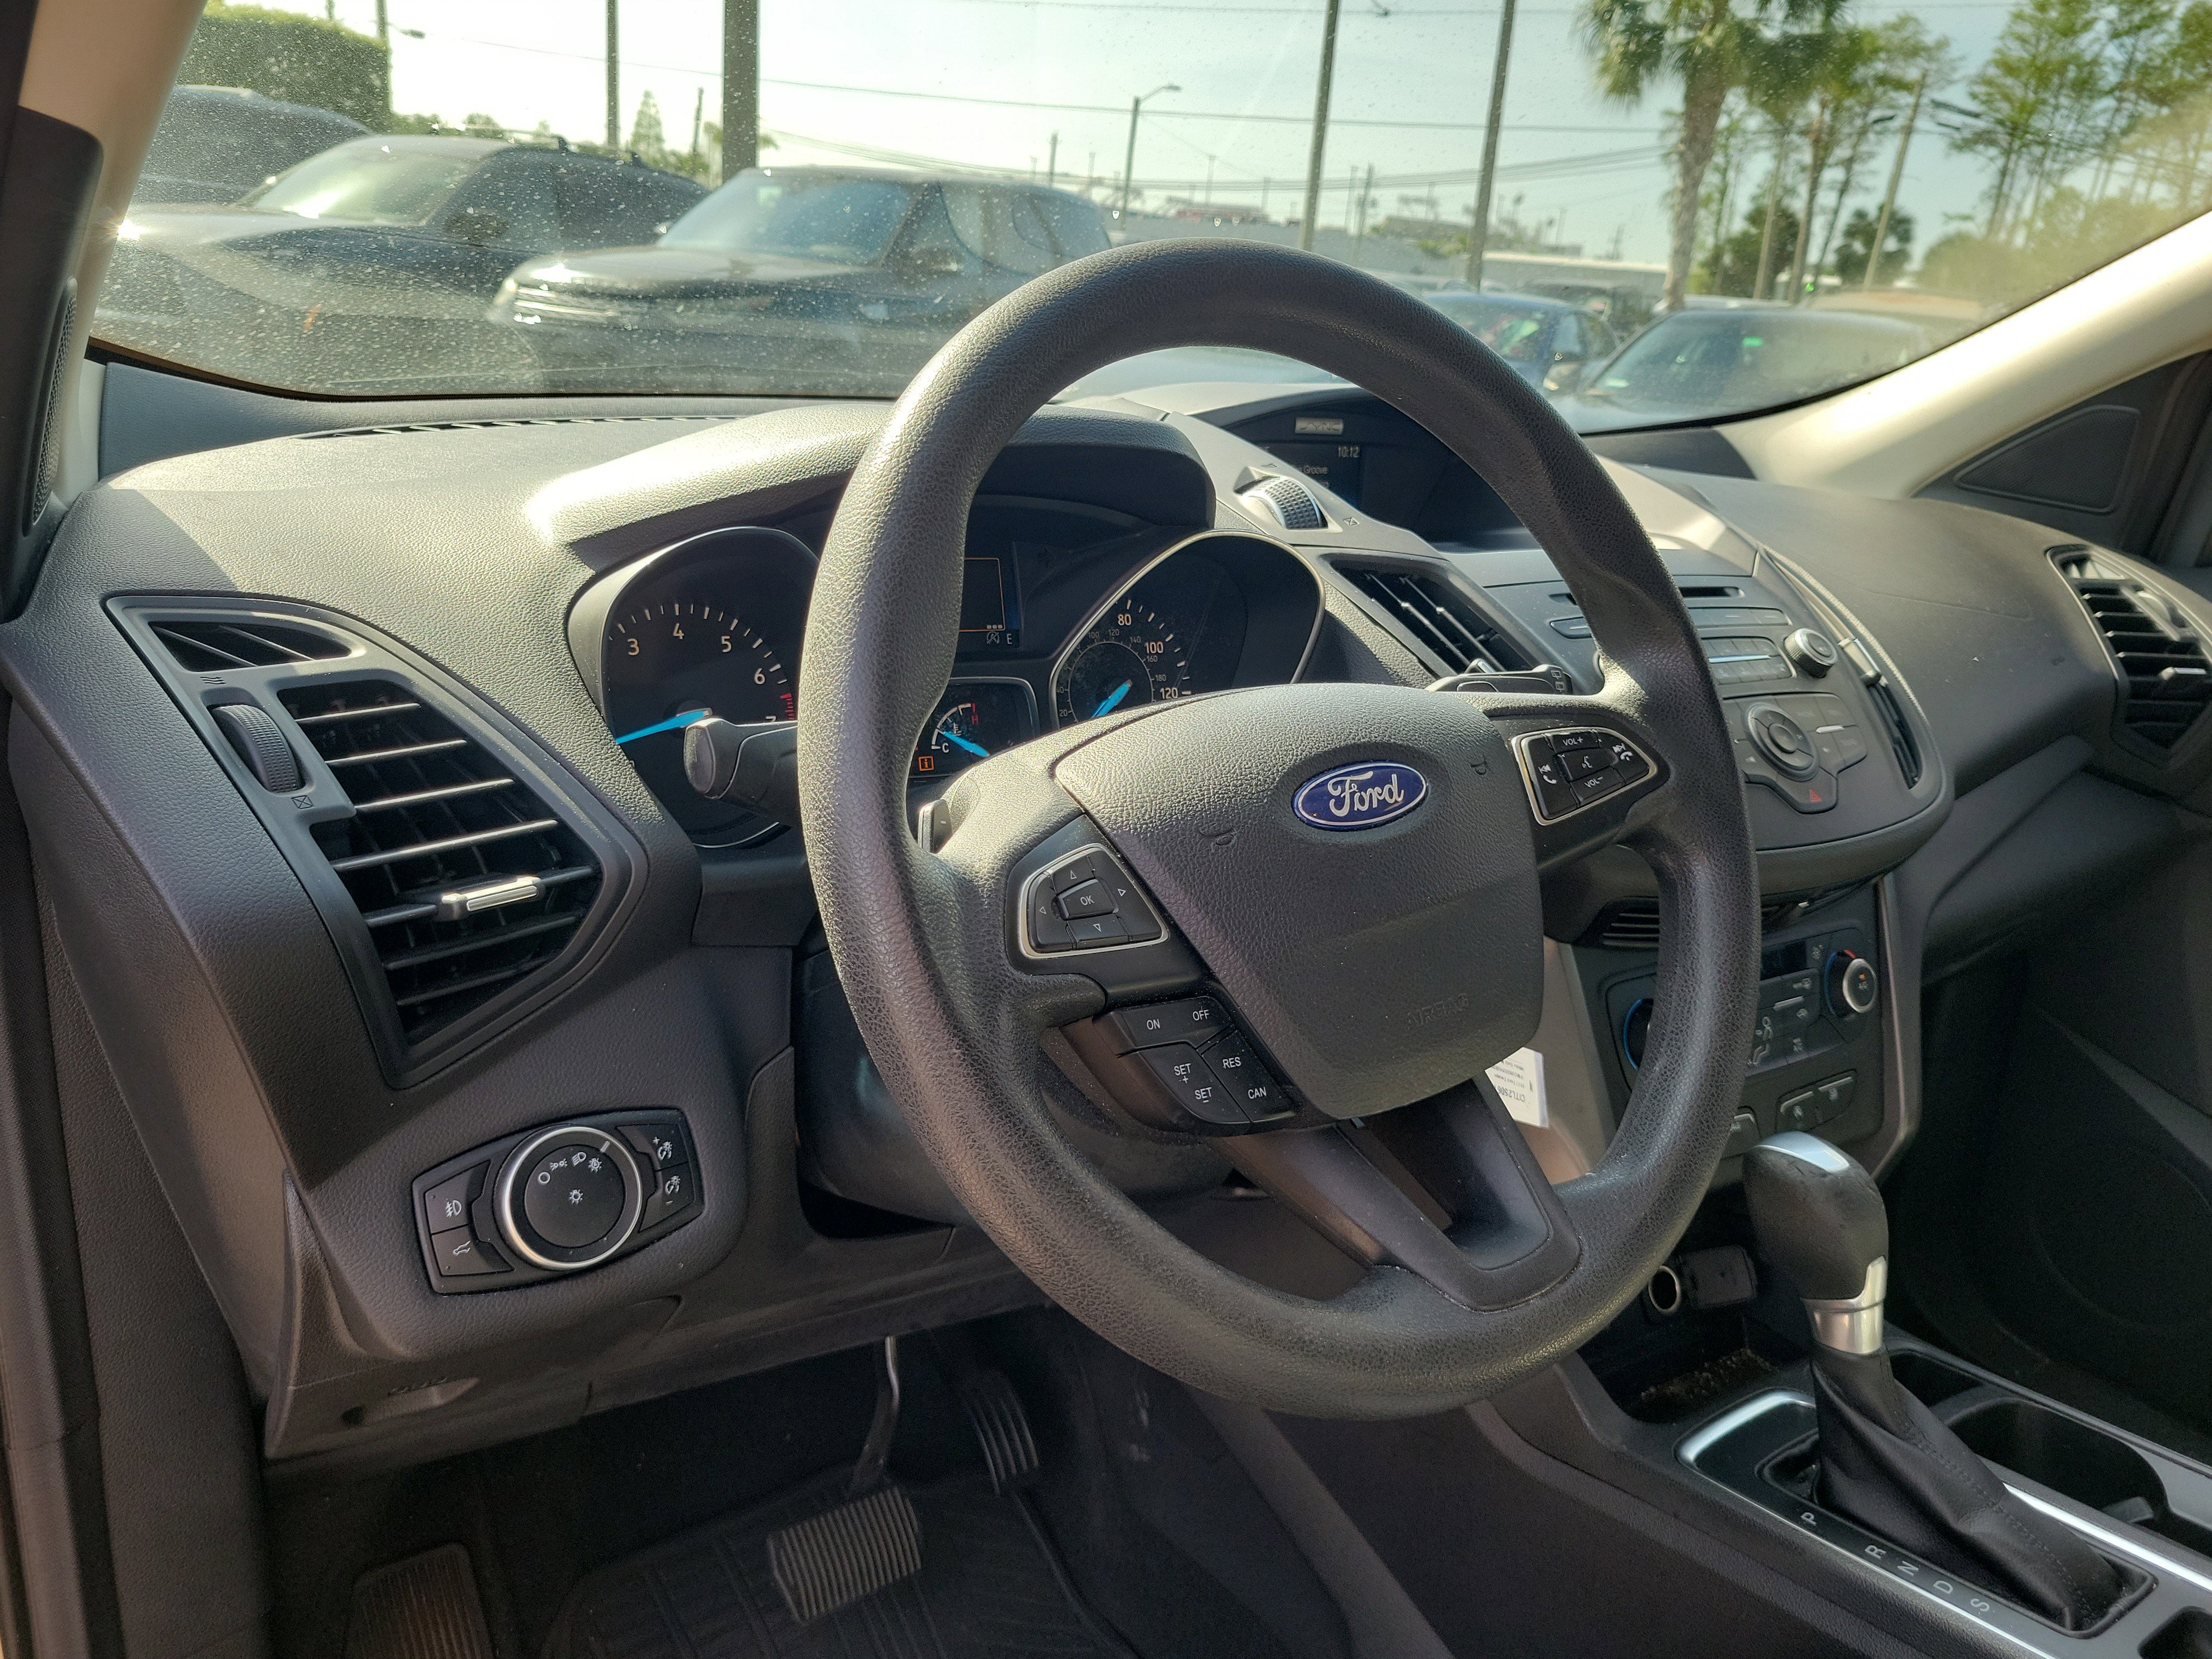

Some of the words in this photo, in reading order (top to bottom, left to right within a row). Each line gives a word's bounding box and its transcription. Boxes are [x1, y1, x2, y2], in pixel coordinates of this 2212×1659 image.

[1300, 422, 1340, 431] SYNC
[1338, 446, 1360, 458] 10:12
[1117, 613, 1132, 626] 80
[673, 623, 684, 640] 4
[1088, 631, 1100, 639] 100
[1108, 628, 1120, 636] 120
[721, 635, 731, 652] 5
[1007, 633, 1013, 644] E
[628, 638, 640, 656] 3
[1144, 641, 1164, 654] 100
[754, 668, 766, 685] 6
[1160, 687, 1178, 699] 120
[971, 714, 979, 725] H
[942, 742, 950, 753] C
[1327, 770, 1404, 817] Ford
[1080, 894, 1095, 906] OK
[1192, 1009, 1209, 1022] OFF
[1146, 1018, 1161, 1030] ON
[1173, 1063, 1192, 1076] SET
[1222, 1057, 1242, 1069] RES
[1194, 1087, 1212, 1100] SET
[1248, 1086, 1267, 1099] CAN
[1800, 1511, 1816, 1526] P
[1864, 1544, 1886, 1560] R
[1897, 1560, 1919, 1577] N
[1932, 1580, 1953, 1594] D
[1970, 1598, 1990, 1612] S
